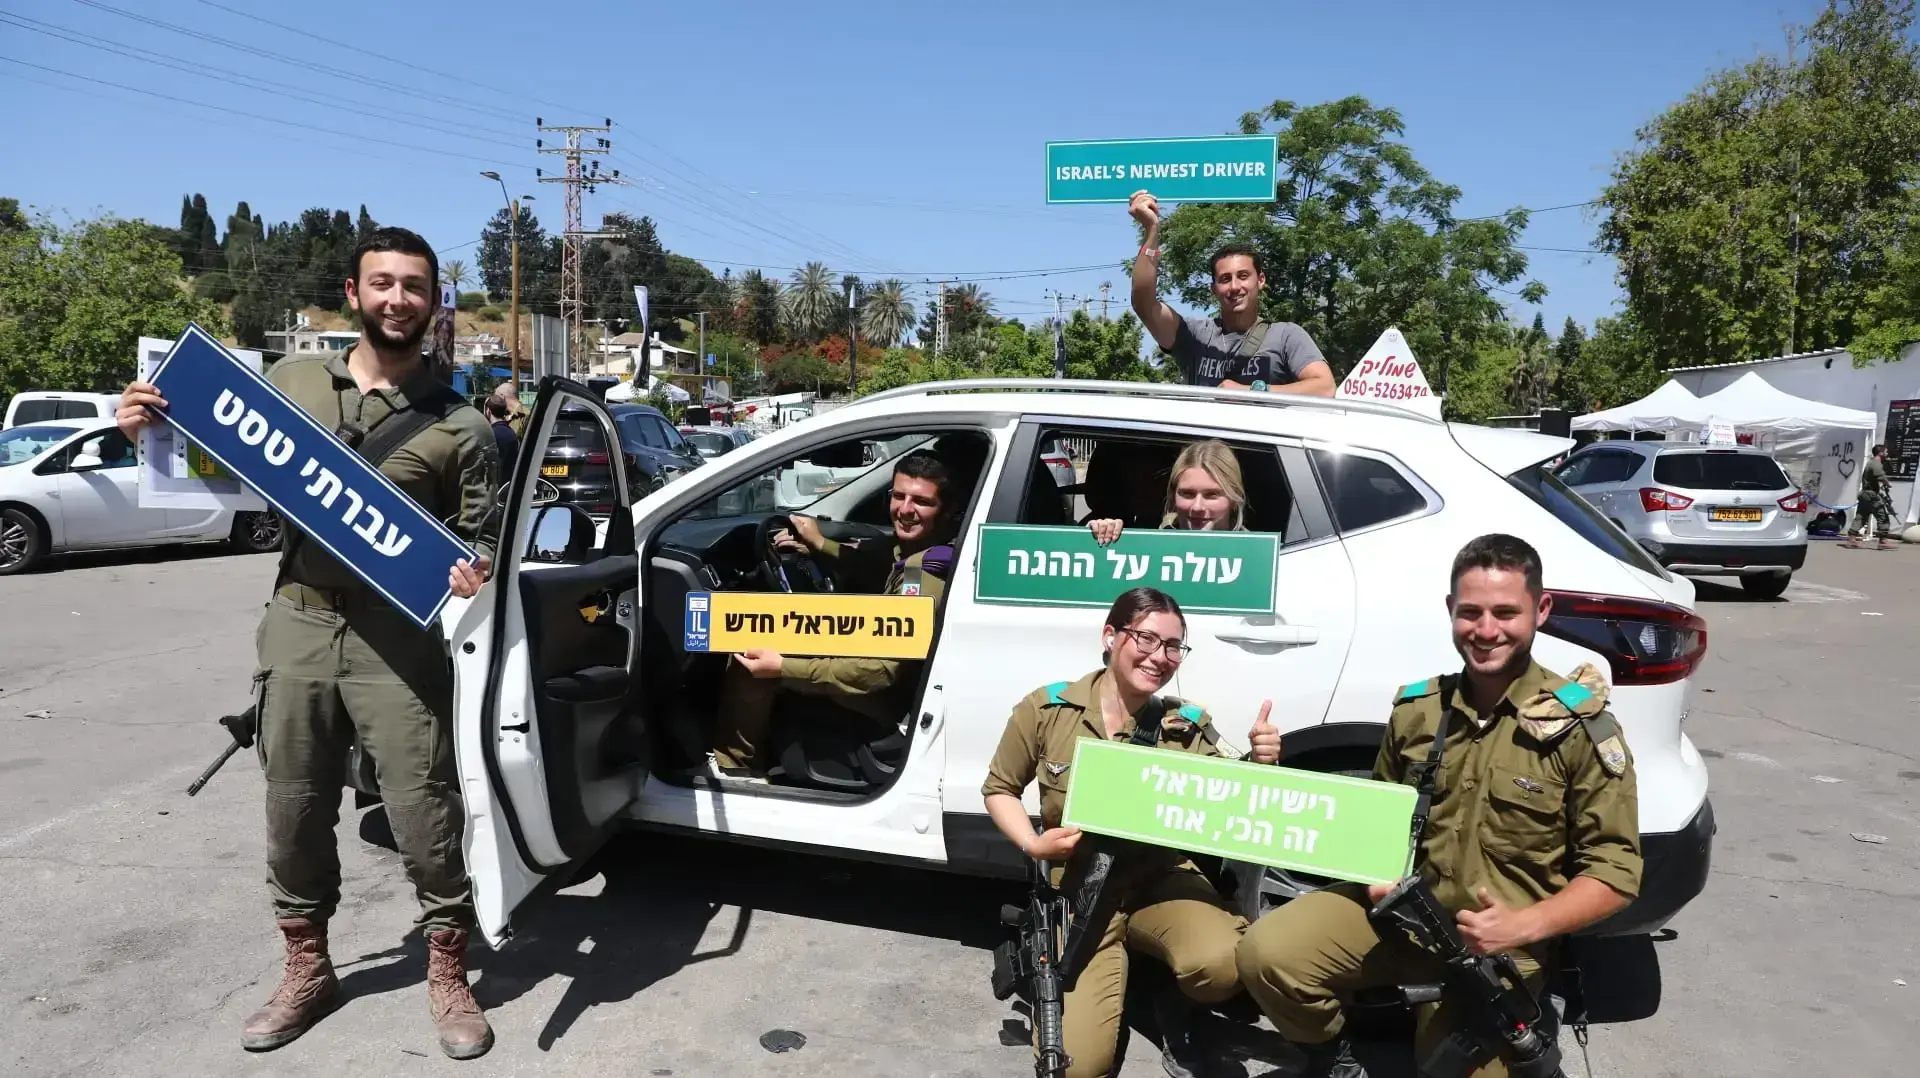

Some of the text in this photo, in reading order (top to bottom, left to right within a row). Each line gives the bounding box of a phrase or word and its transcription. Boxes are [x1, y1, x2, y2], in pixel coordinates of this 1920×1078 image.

[1056, 161, 1266, 181] ISRAEL'S NEWEST DRIVER
[1359, 355, 1417, 378] שמוליק
[213, 387, 414, 558] עברתי טסט
[1007, 548, 1243, 585] עולה על ההגה
[692, 611, 707, 633] IL
[725, 610, 915, 638] נהג ישראלי חדש
[1140, 763, 1336, 821] רישיון ישראלי
[1155, 802, 1320, 854] זה הכי, אחי
